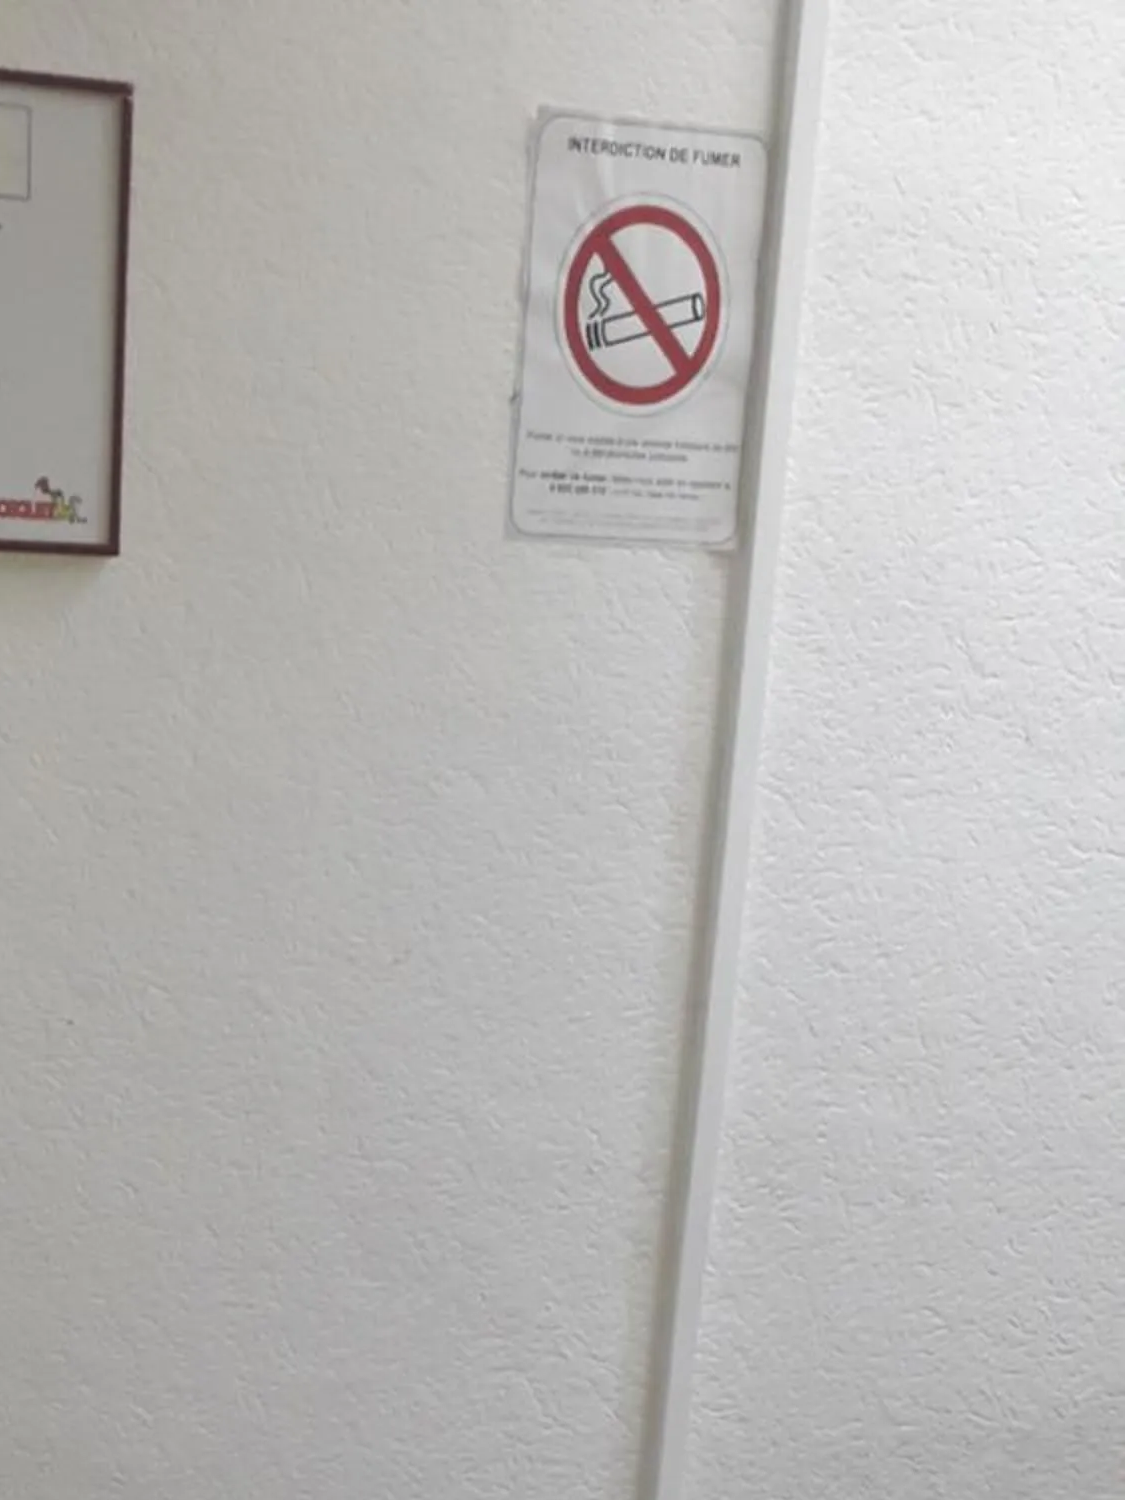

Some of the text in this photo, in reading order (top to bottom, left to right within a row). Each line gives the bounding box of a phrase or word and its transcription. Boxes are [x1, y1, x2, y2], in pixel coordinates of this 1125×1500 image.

[567, 137, 741, 168] INTERDICTION DE FUMER
